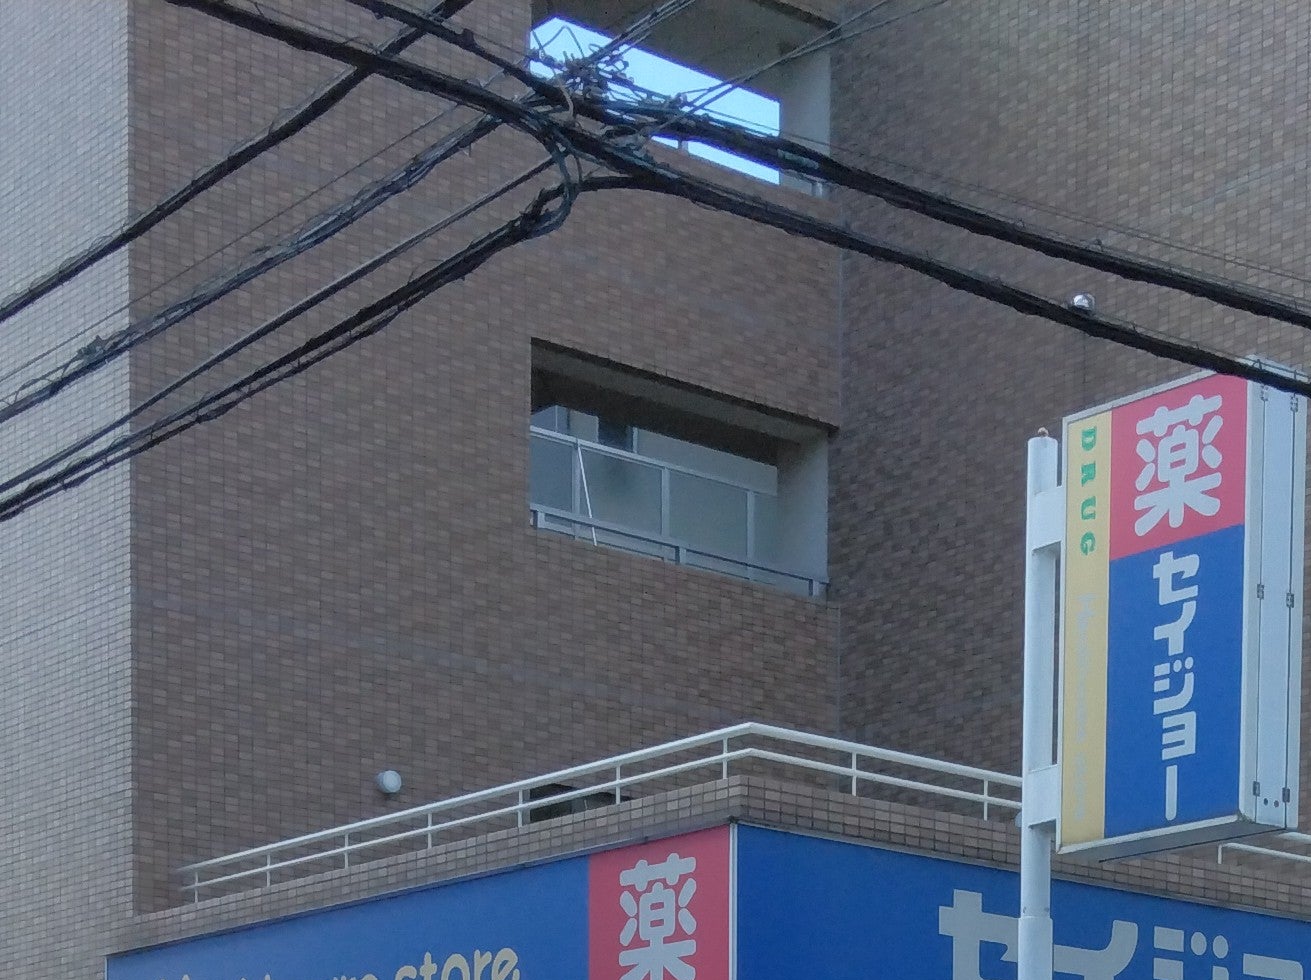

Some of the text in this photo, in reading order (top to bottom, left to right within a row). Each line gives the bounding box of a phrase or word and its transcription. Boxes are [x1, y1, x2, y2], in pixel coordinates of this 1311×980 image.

[1080, 426, 1097, 556] DRUG
[1134, 394, 1223, 537] 薬
[1152, 551, 1199, 821] セイジョー
